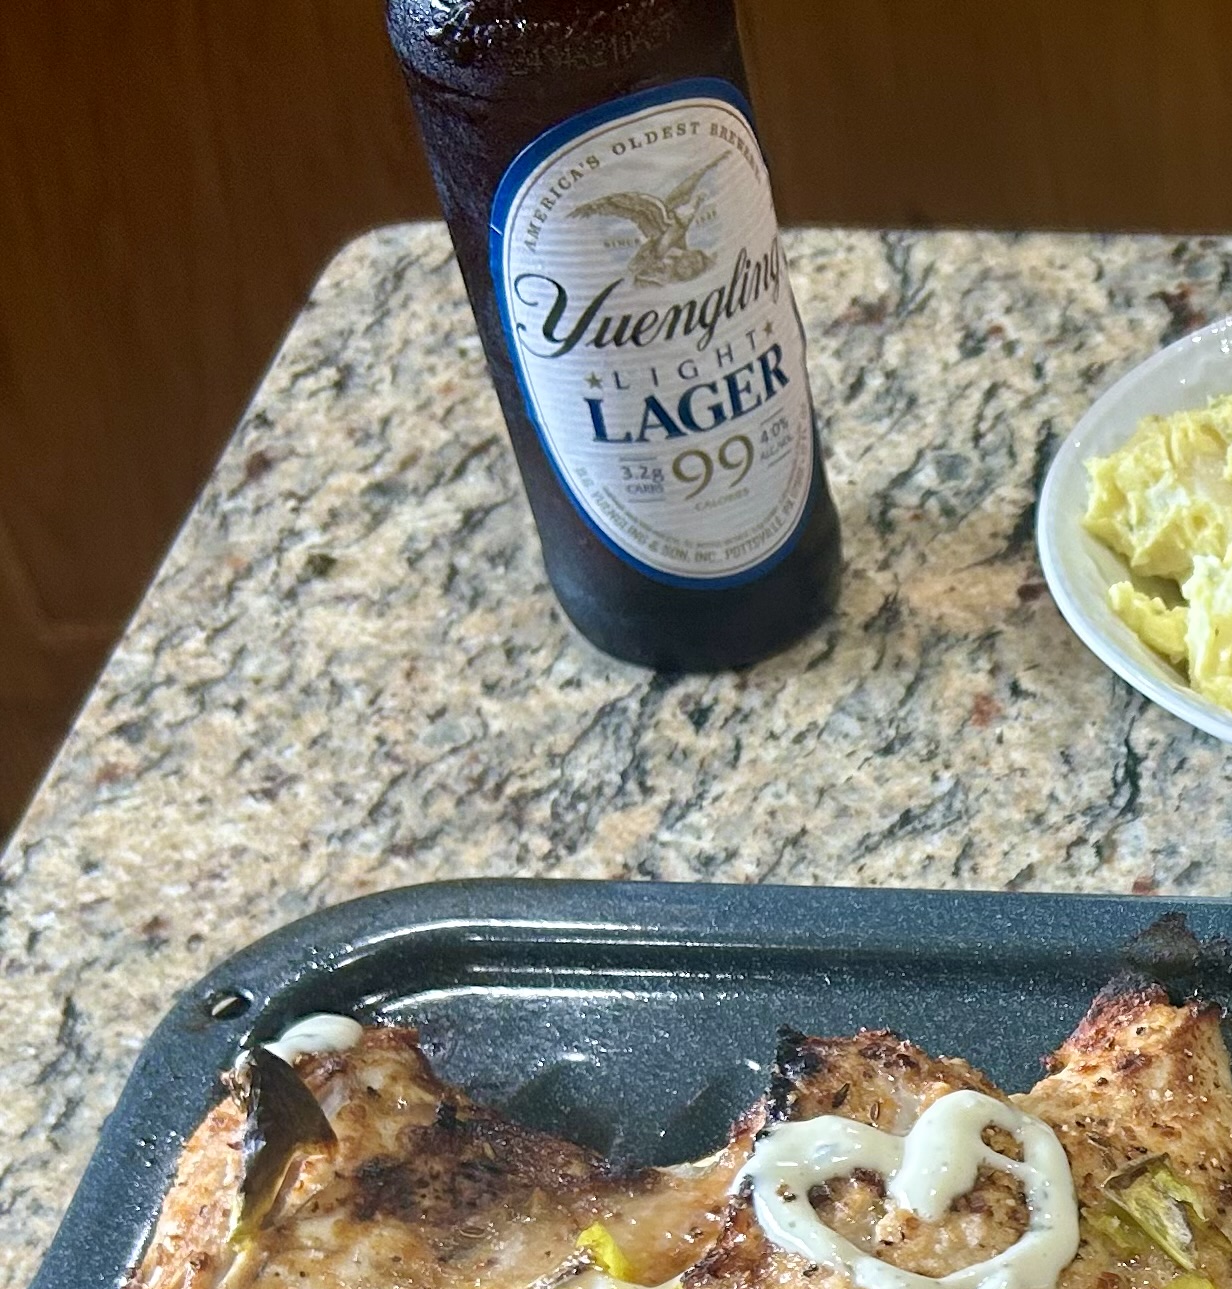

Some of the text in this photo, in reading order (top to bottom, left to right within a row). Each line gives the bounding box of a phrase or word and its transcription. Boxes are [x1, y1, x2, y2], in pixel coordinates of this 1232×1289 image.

[524, 154, 600, 253] AMERICA'S
[611, 121, 700, 156] OLDEST
[513, 234, 781, 359] Yuengling
[584, 343, 790, 443] LAGER
[613, 329, 756, 390] LIGHT
[671, 434, 755, 500] 99
